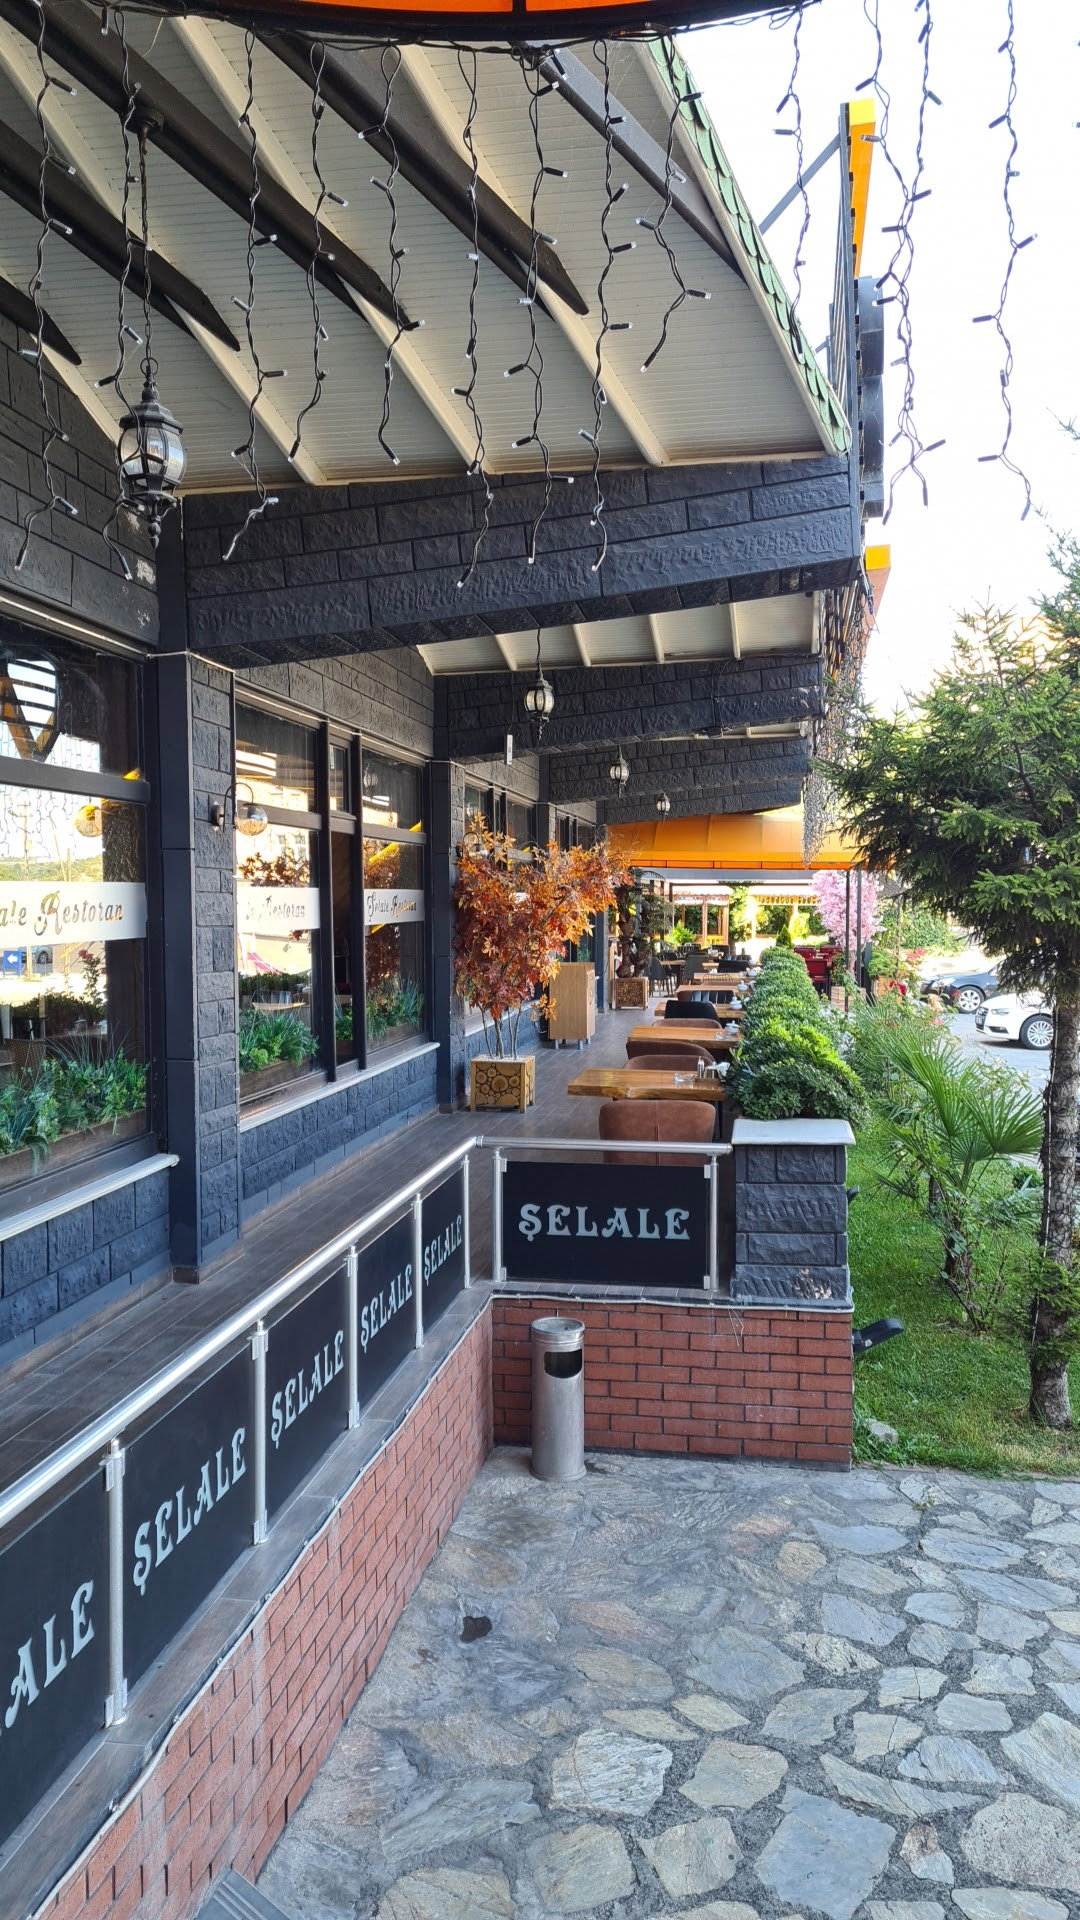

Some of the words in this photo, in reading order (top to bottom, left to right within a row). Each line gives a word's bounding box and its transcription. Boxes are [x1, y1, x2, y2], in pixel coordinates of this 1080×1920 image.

[34, 890, 124, 936] Restoran
[423, 1214, 463, 1287] ŞELALE
[518, 1203, 690, 1242] ŞELALE
[360, 1263, 413, 1354] ŞELALE
[270, 1329, 345, 1450] ŞELALE
[133, 1426, 248, 1596] ŞELALE
[0, 1579, 95, 1735] ALE
